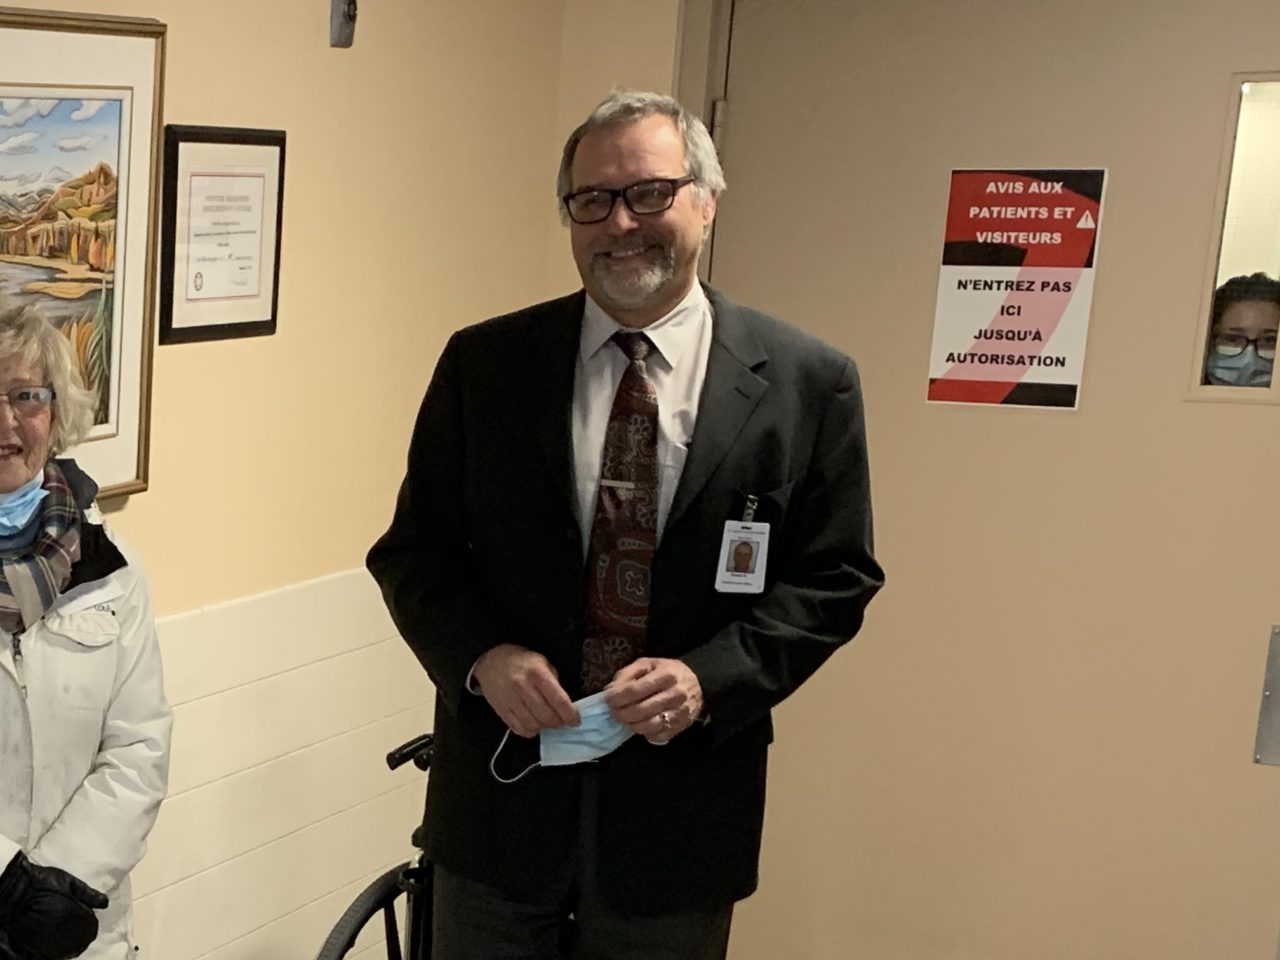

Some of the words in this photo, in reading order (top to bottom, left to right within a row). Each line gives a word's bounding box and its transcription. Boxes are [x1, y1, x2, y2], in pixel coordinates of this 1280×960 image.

[986, 181, 1024, 194] AVIS
[1028, 181, 1064, 194] AUX
[969, 206, 1049, 219] PATIENTS
[1053, 206, 1075, 219] ET
[976, 231, 1062, 244] VISITEURS
[957, 279, 1036, 292] N'ENTREZ
[1040, 280, 1072, 293] PAS
[1000, 304, 1022, 316] ICI
[945, 352, 1066, 367] AUTORISATION
